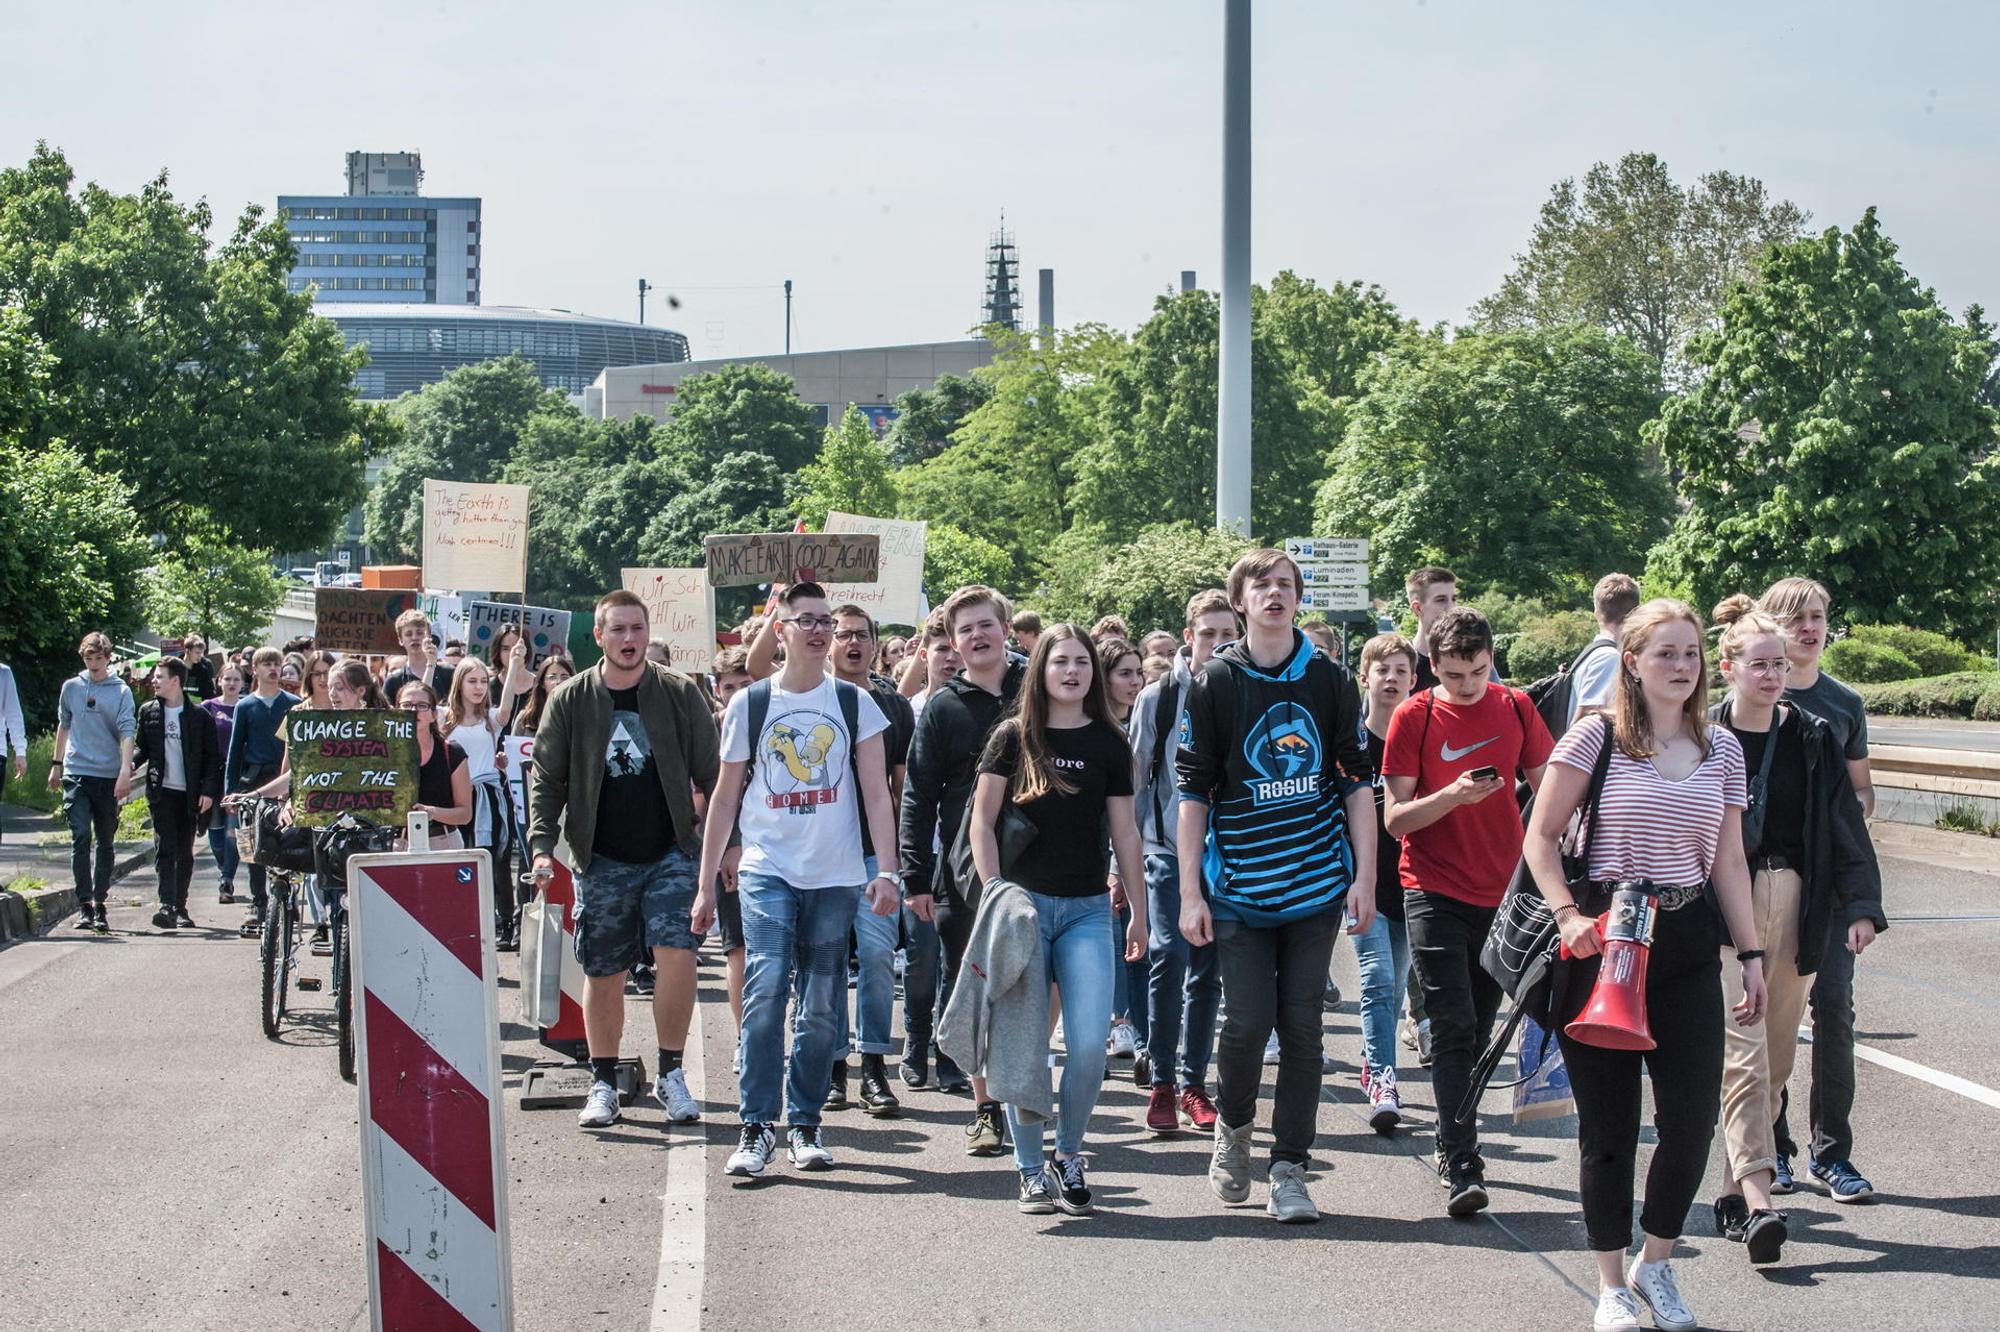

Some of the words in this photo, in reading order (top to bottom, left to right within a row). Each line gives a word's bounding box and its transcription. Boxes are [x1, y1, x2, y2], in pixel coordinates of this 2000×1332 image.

[433, 488, 454, 507] The
[457, 492, 494, 511] Earth
[498, 495, 510, 511] is
[710, 545, 754, 580] MAKE
[795, 543, 831, 569] COOL
[835, 543, 879, 570] AGAIN
[319, 611, 386, 625] DACHTEN
[472, 604, 532, 625] THERE
[540, 613, 555, 628] IS
[317, 627, 351, 639] AUCH
[355, 628, 376, 640] SIE
[293, 719, 367, 742] CHANGE
[383, 719, 413, 739] THE
[319, 740, 388, 759] SYSTEM
[1050, 756, 1085, 770] ore
[302, 771, 343, 787] NOT
[360, 770, 399, 787] THE
[1257, 775, 1319, 800] ROGUE
[304, 791, 395, 813] CLIMATE
